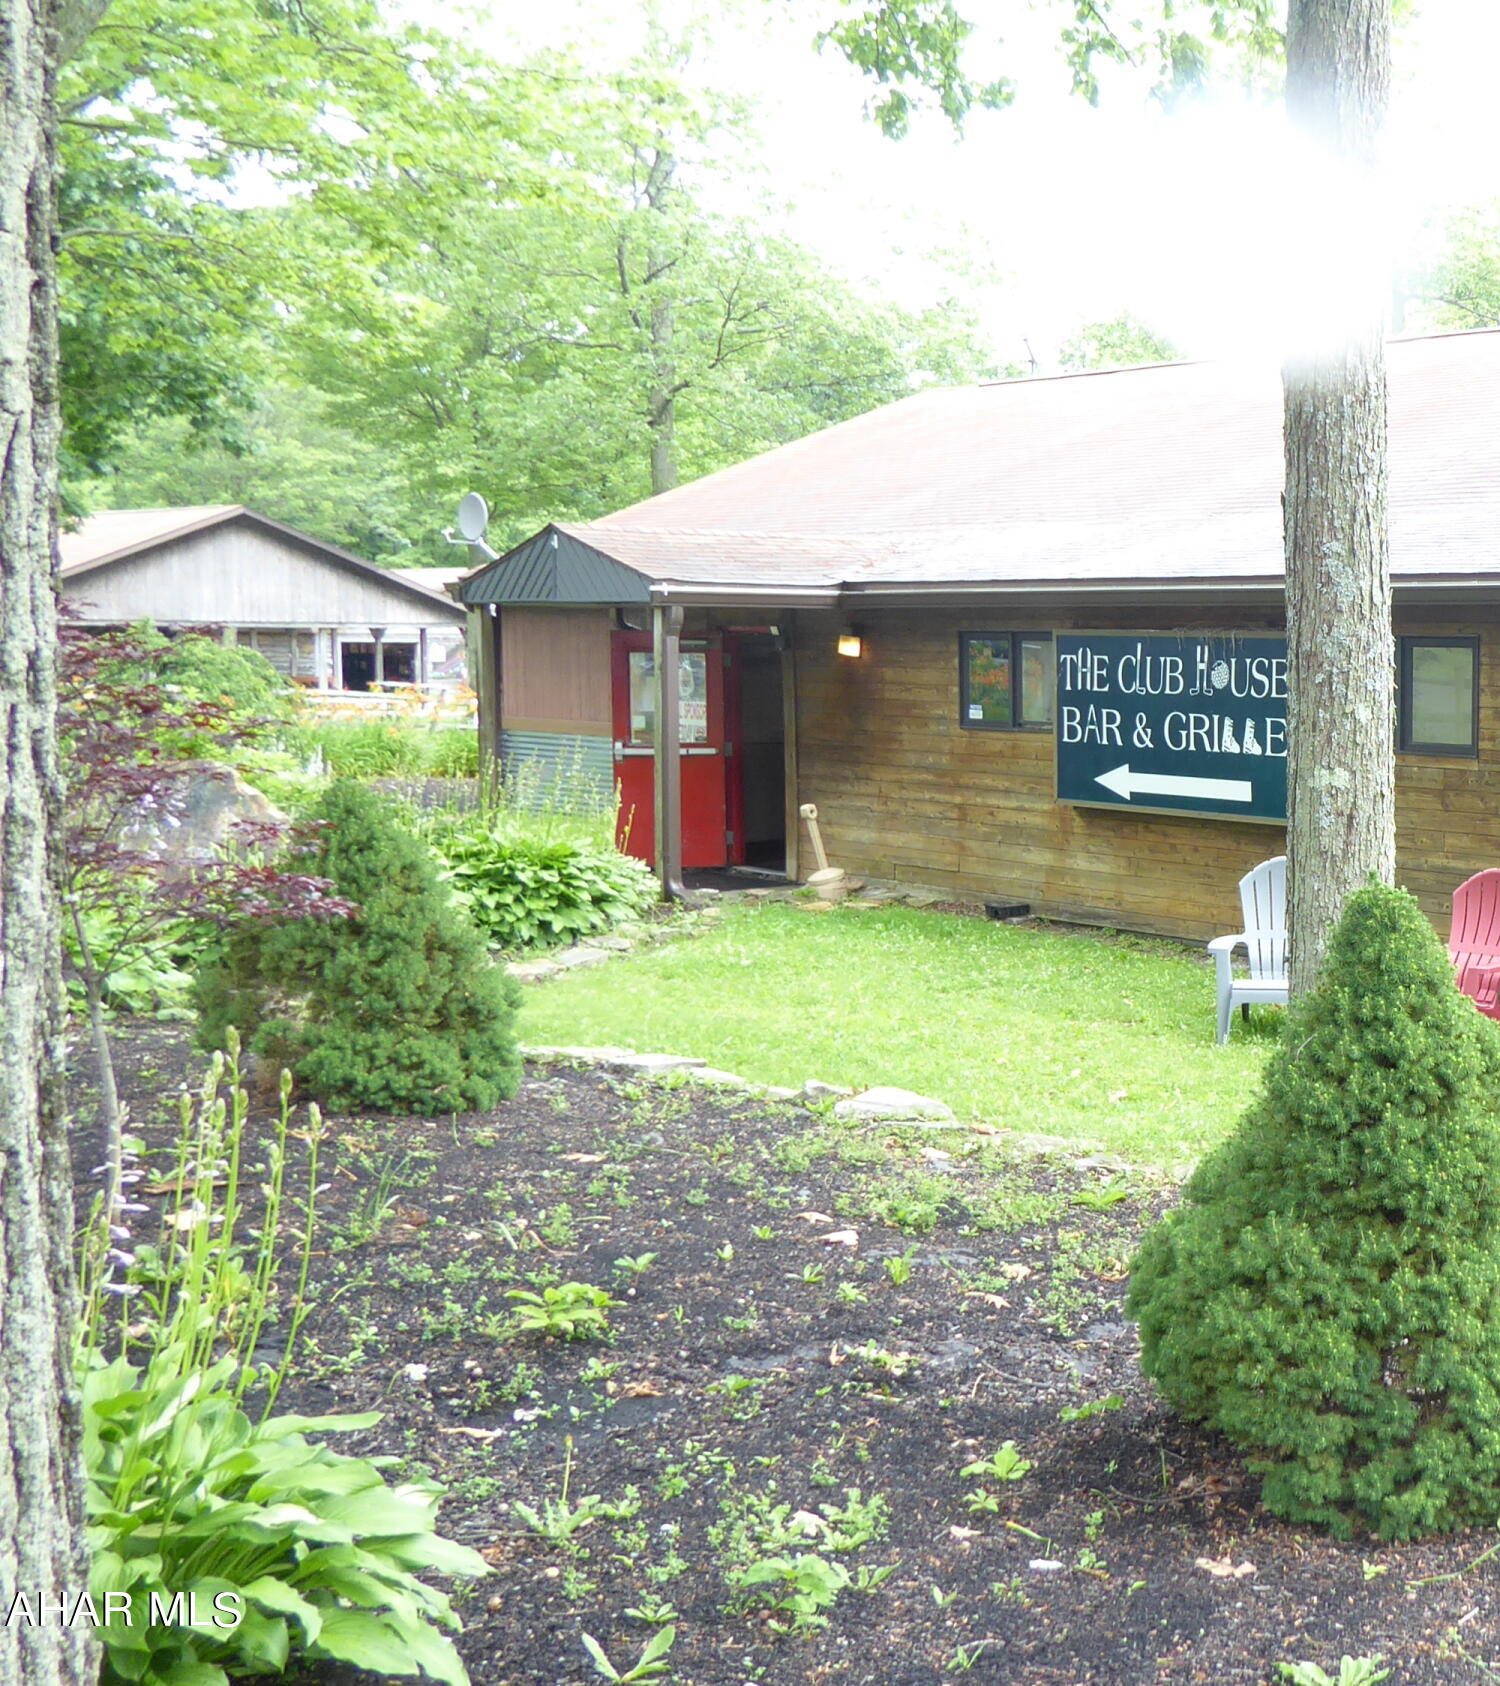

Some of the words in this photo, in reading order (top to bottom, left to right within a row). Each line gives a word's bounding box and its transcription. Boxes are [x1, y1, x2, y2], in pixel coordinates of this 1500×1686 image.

[1060, 647, 1109, 692] THE
[1117, 642, 1184, 695] CLUB
[1190, 645, 1287, 698] HOUSE
[1062, 704, 1123, 746] BAR
[1132, 713, 1154, 749] &
